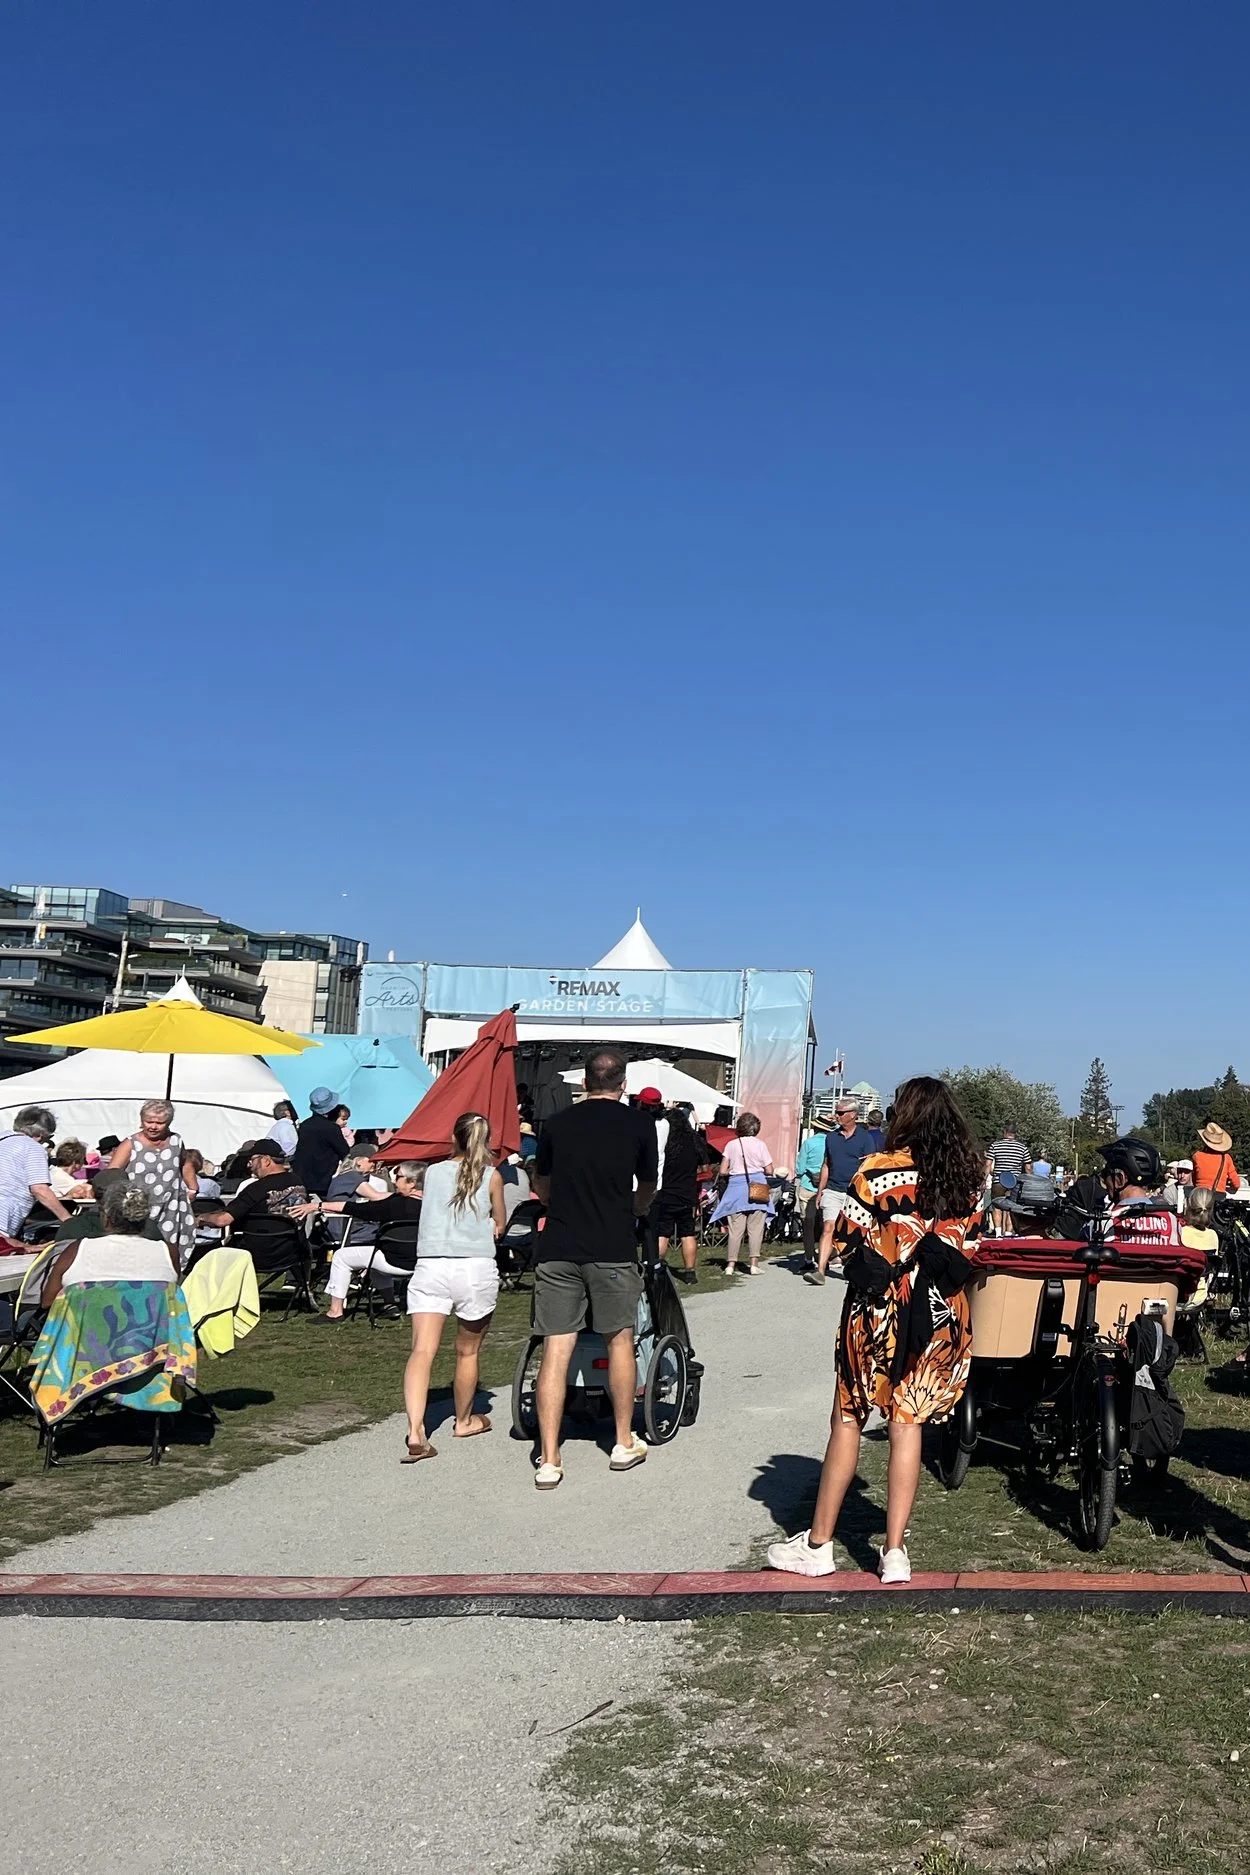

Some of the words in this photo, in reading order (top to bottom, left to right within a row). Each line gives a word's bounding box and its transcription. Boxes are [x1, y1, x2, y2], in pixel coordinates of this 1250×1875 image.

[557, 980, 621, 997] REMAX
[365, 991, 415, 1008] Arts
[519, 999, 588, 1012] GARDEN
[596, 1000, 654, 1013] STAGE
